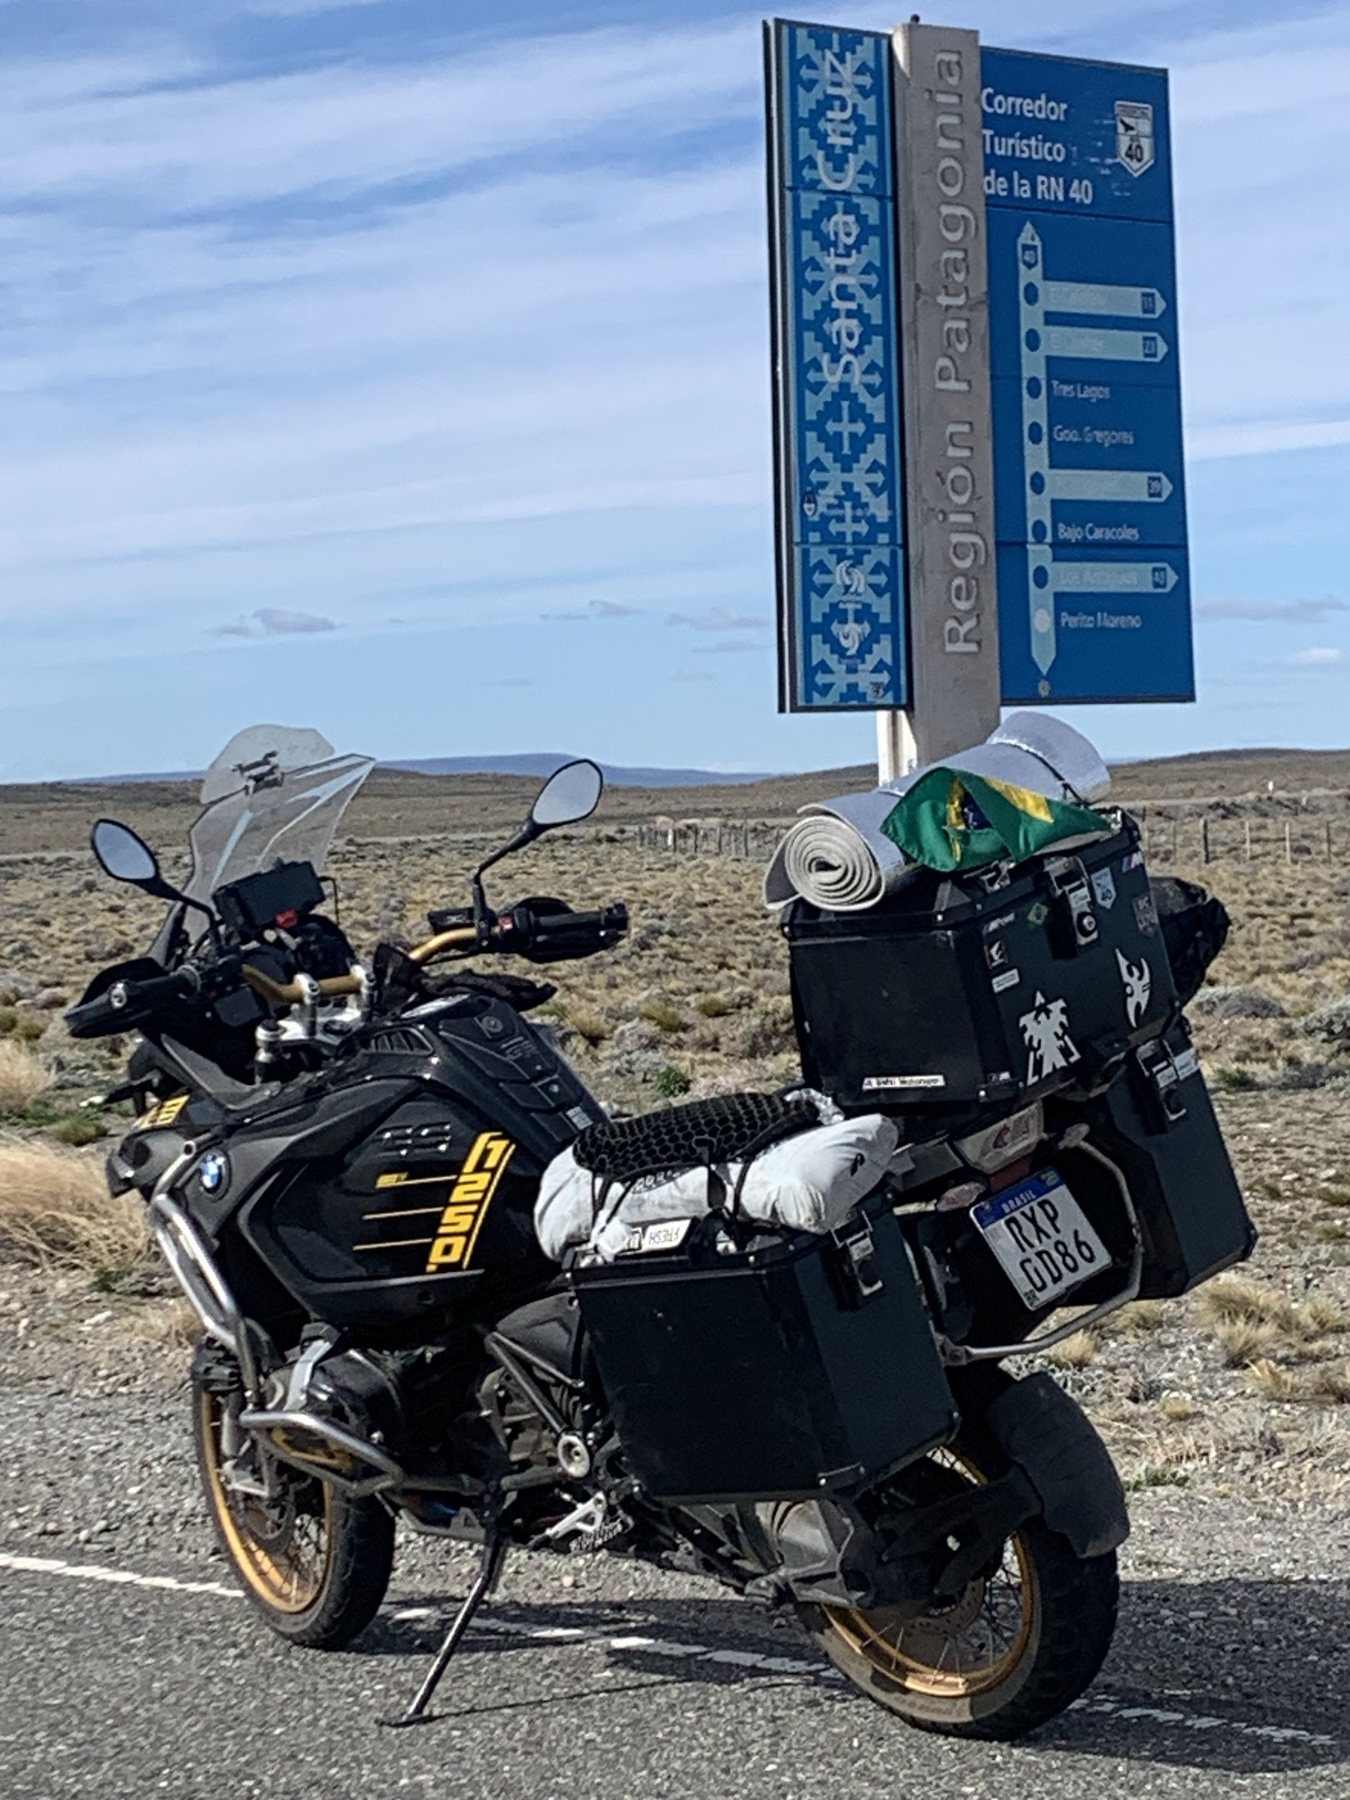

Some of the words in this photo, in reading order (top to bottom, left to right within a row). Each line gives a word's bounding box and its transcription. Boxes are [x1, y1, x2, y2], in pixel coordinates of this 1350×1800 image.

[817, 49, 856, 192] Cruz
[981, 87, 1068, 122] Corredor
[982, 129, 1066, 163] Turístico
[1125, 142, 1145, 164] 40
[984, 168, 1010, 196] de
[1013, 170, 1031, 199] la
[1036, 175, 1064, 202] RN
[1069, 178, 1093, 205] 40
[925, 50, 980, 391] Patagonia
[822, 213, 861, 385] Santa
[1052, 380, 1076, 398] Tres
[1077, 382, 1111, 403] Lagos
[936, 421, 988, 655] Región
[1057, 522, 1083, 543] Bajo
[1085, 523, 1140, 542] Caracoles
[1060, 611, 1095, 629] Perito
[1096, 611, 1143, 629] Moreno
[429, 1137, 511, 1265] 1250
[1001, 1189, 1038, 1214] BRASIL
[1003, 1198, 1061, 1253] RXP
[1018, 1228, 1097, 1293] GD86
